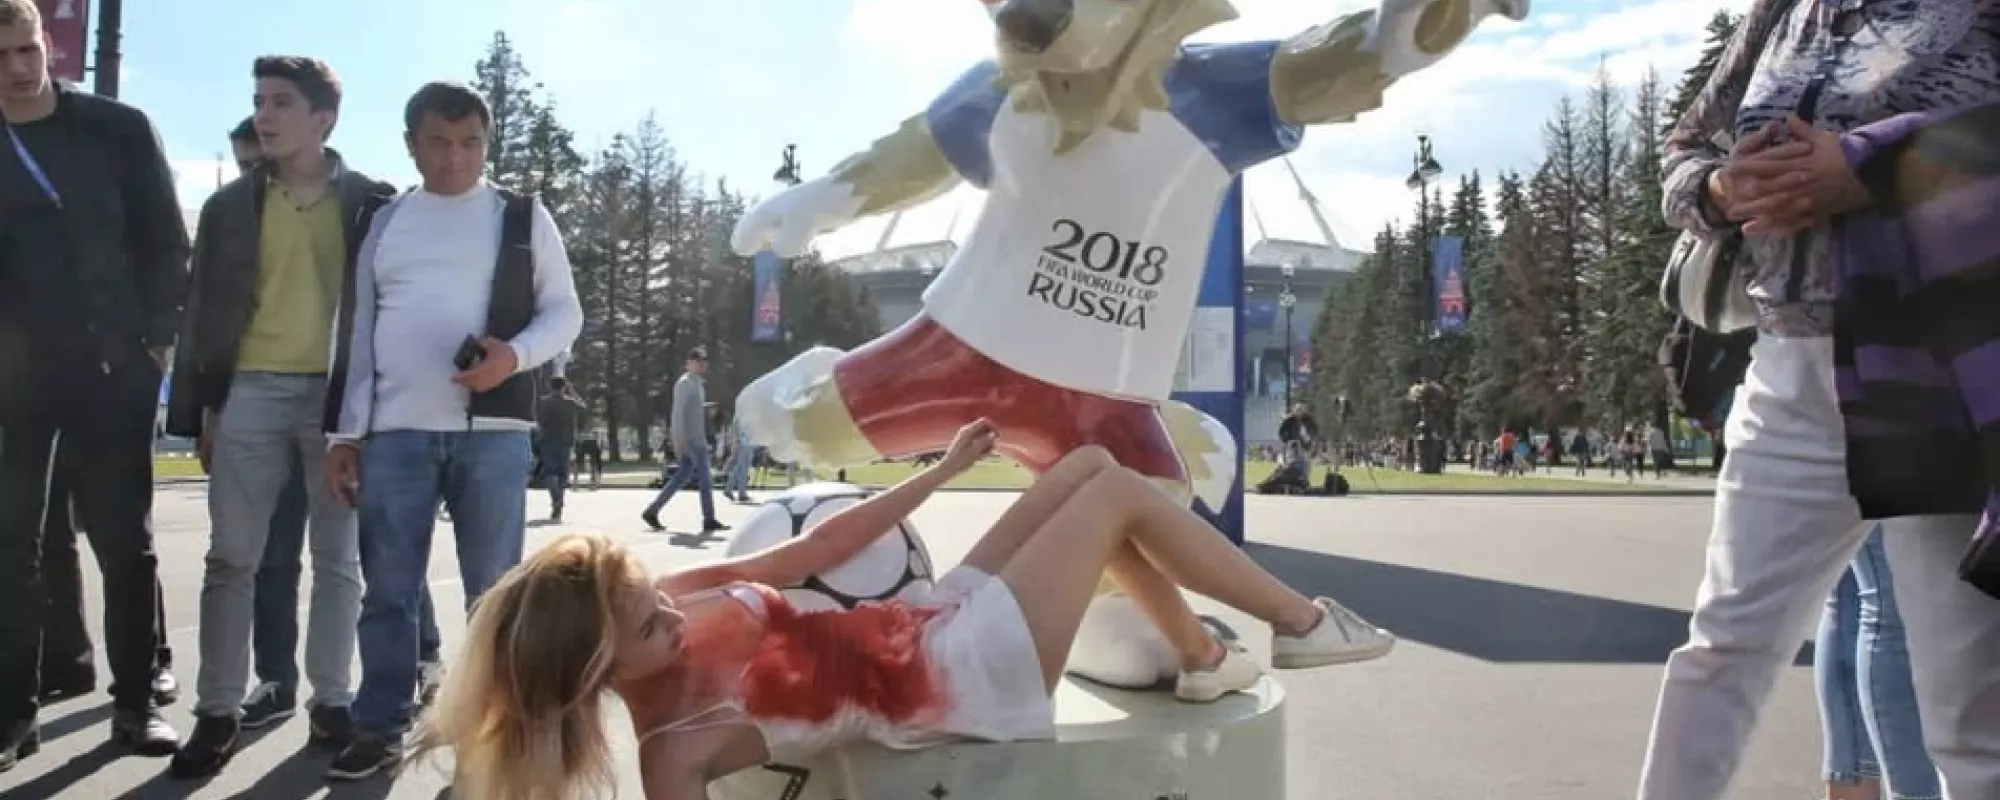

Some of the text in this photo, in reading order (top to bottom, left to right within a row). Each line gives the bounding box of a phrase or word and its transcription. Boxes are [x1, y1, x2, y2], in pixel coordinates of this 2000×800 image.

[1036, 254, 1159, 302] FIFA WORLD CUP
[1042, 218, 1168, 285] 2018
[1026, 271, 1146, 331] RUSSIA
